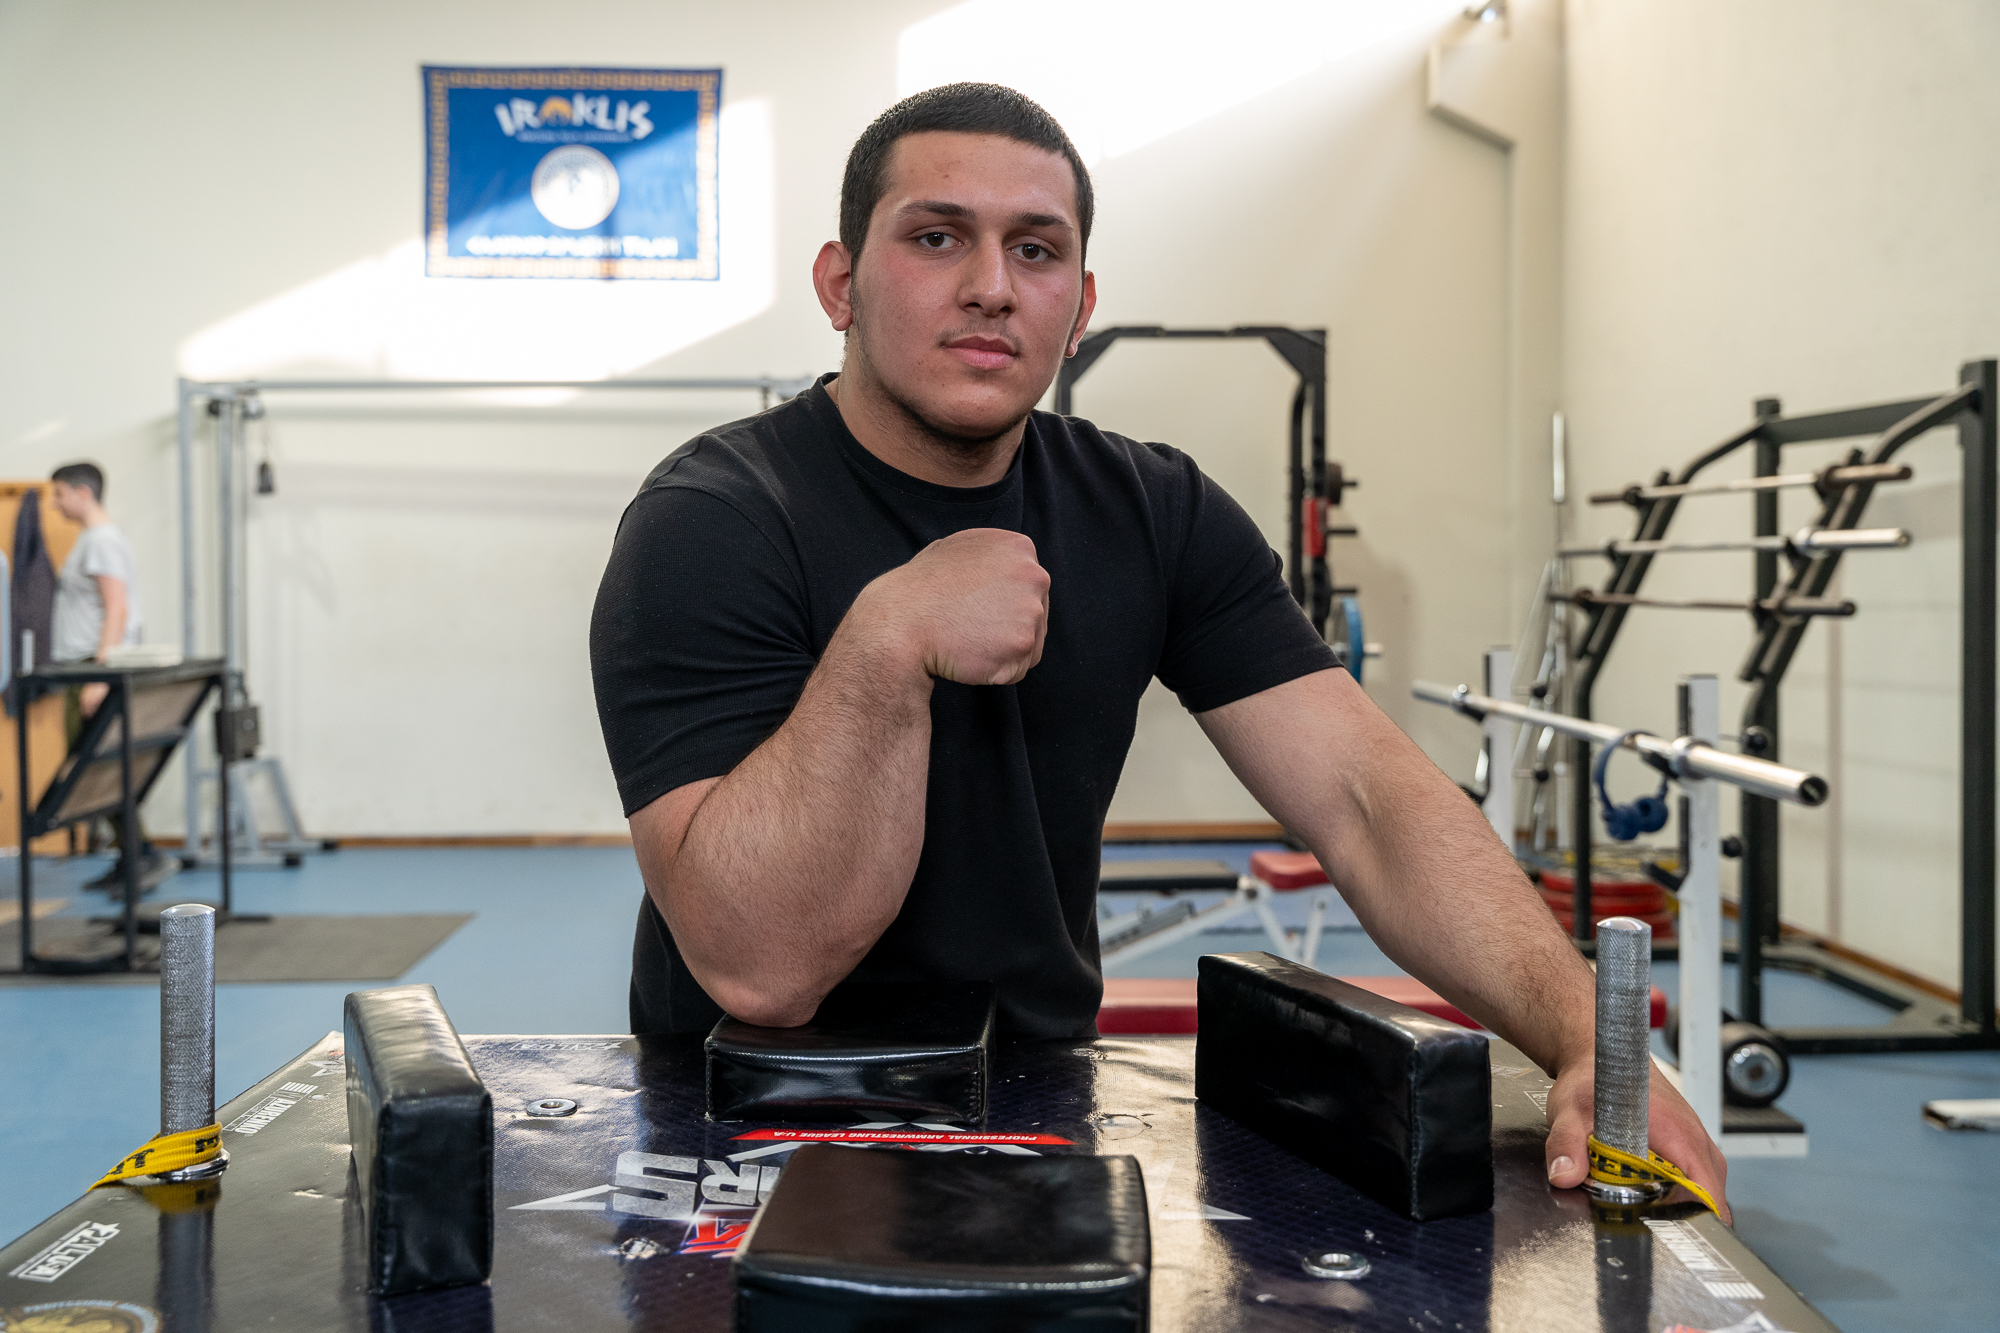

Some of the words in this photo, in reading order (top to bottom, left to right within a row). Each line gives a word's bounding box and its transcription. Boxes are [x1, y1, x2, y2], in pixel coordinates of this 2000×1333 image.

[798, 1131, 846, 1139] LEAGUE
[848, 1131, 946, 1140] ARMWRESTLING
[947, 1133, 1038, 1141] PROFESSIONAL
